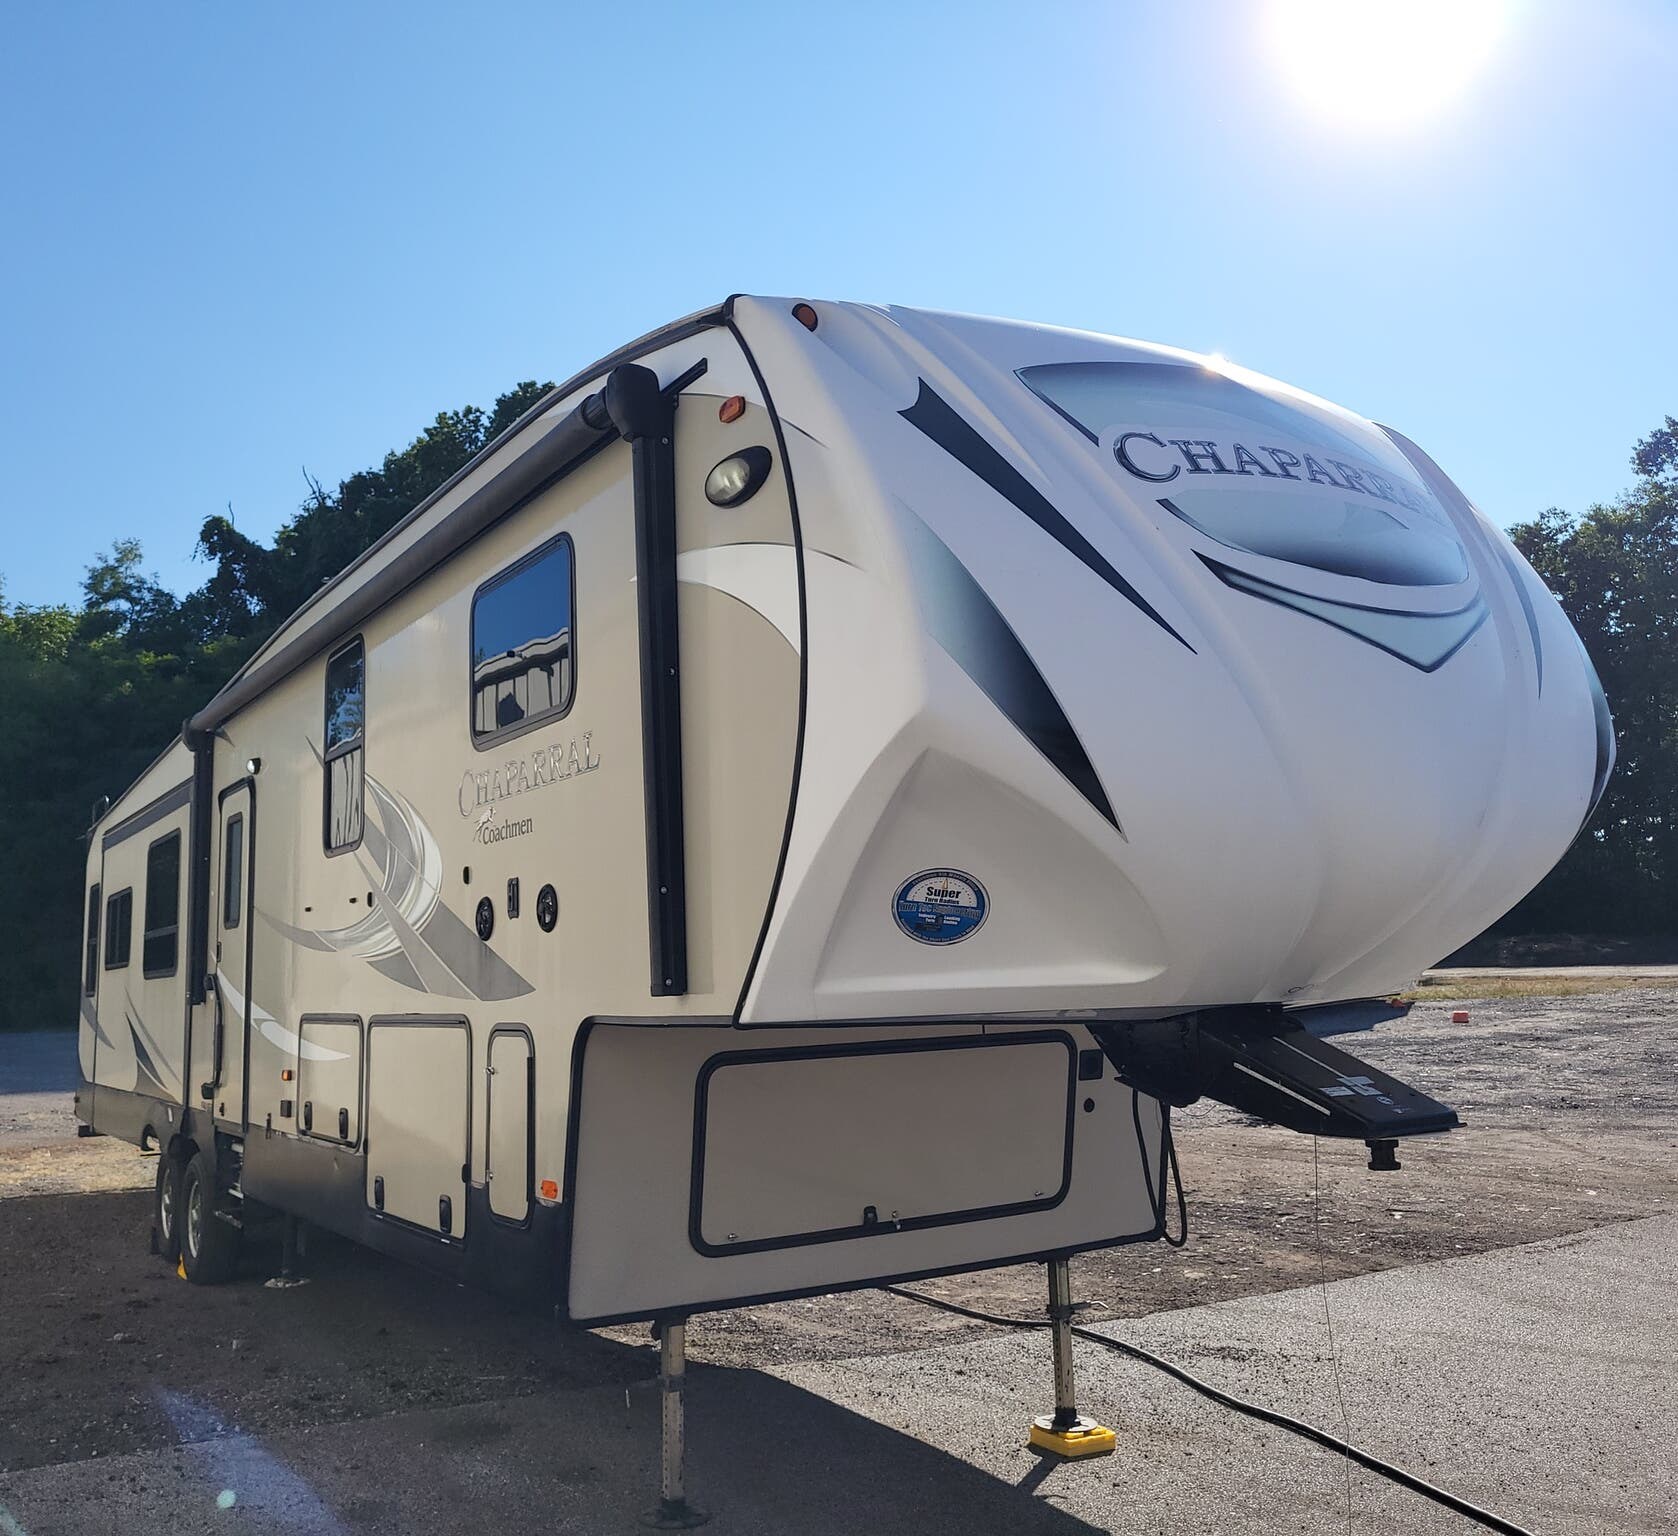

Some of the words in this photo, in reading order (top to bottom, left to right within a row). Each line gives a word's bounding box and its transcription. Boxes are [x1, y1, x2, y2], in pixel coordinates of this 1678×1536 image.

[459, 730, 601, 819] CHAPARRAL
[482, 817, 533, 845] Coachmen
[926, 886, 962, 899] Super
